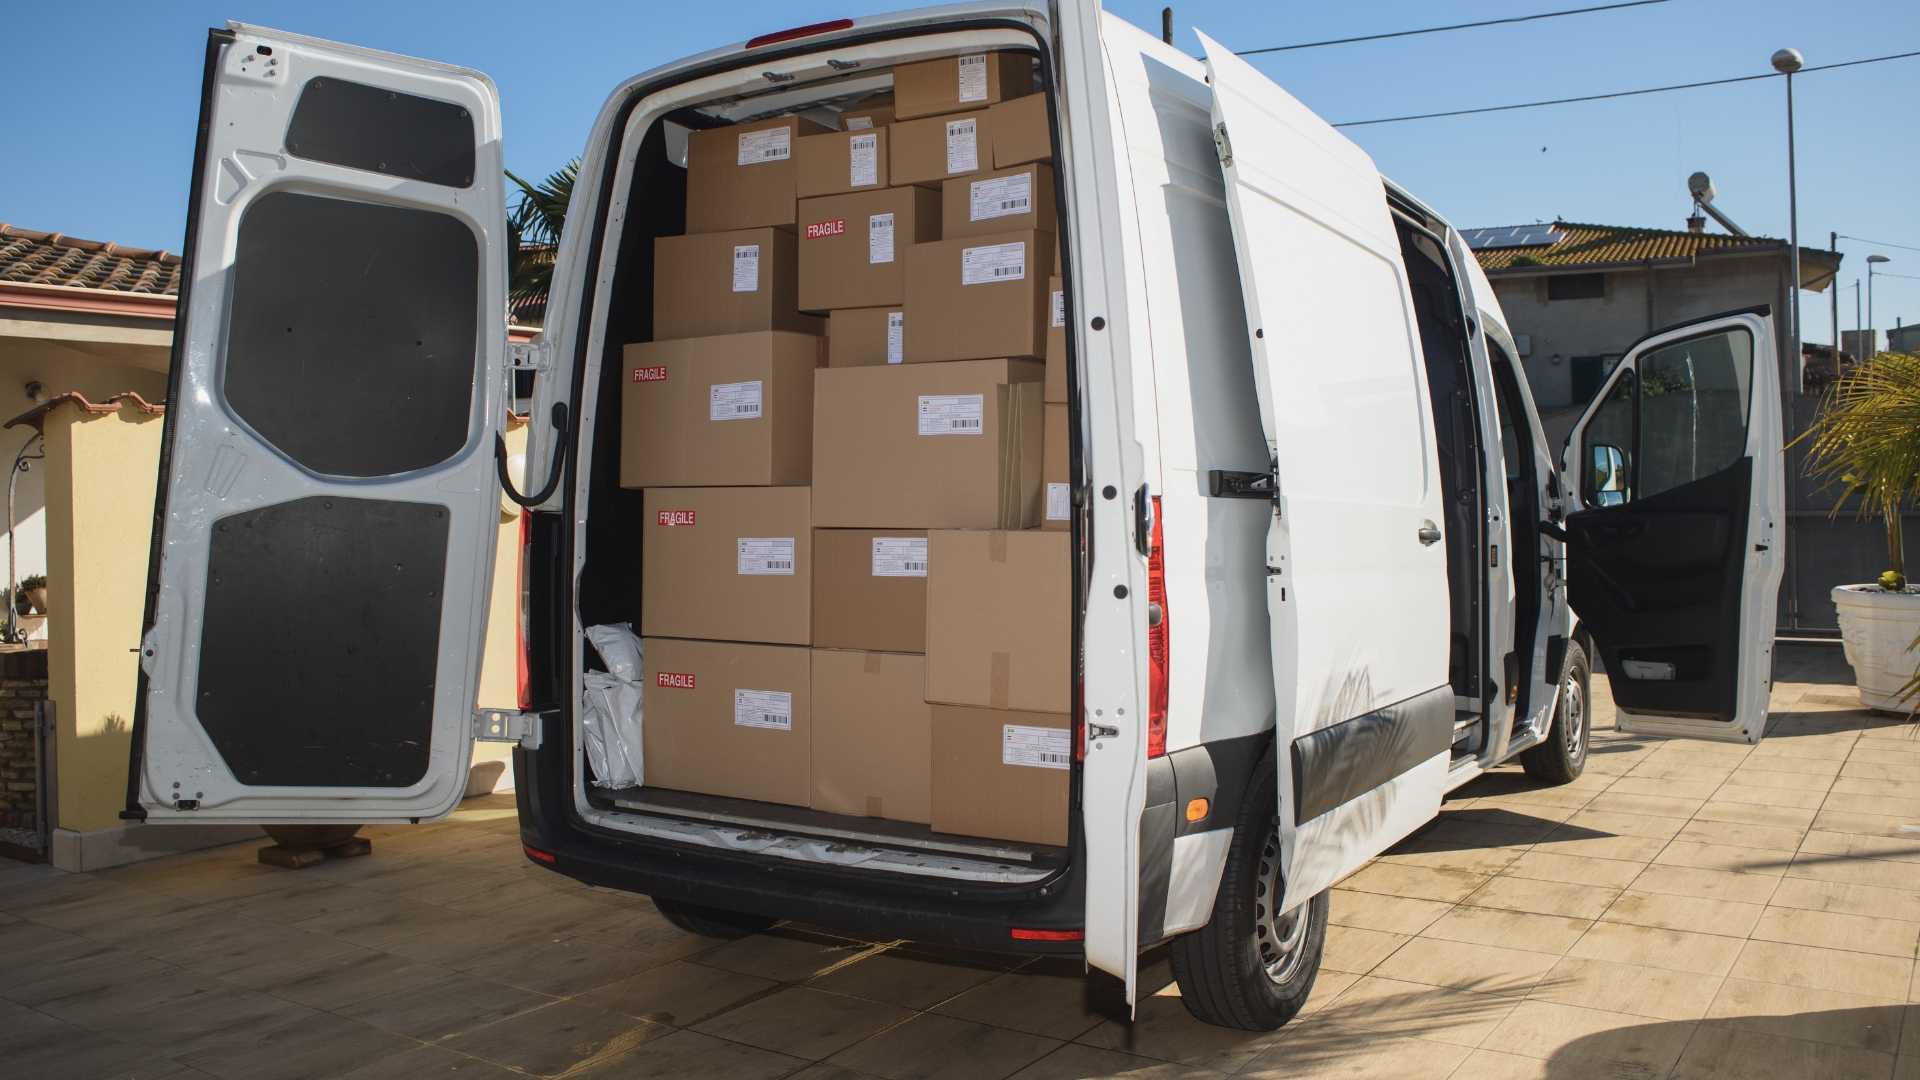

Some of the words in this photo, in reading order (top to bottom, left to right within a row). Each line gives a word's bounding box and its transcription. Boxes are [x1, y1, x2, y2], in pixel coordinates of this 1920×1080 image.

[807, 220, 844, 238] FRAGILE
[634, 367, 666, 381] FRAGILE
[659, 512, 694, 525] FRAGILE
[659, 673, 694, 688] FRAGILE
